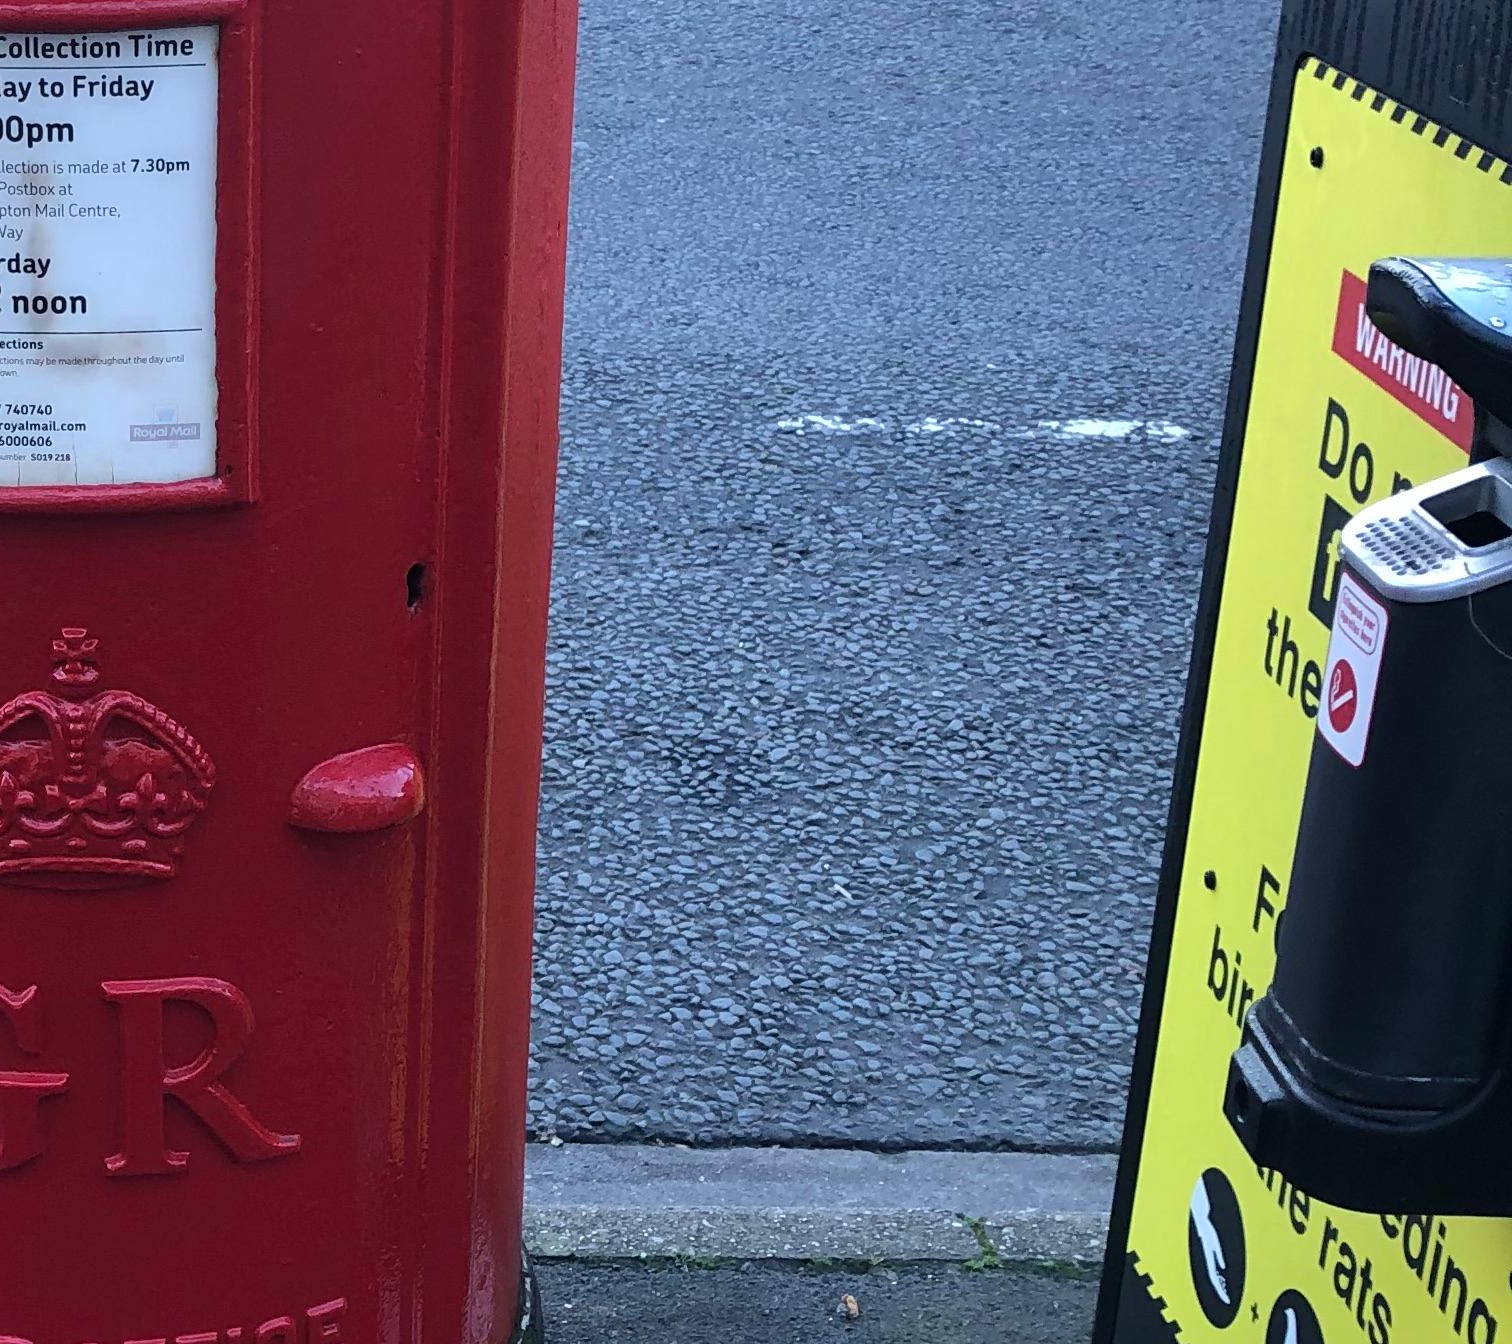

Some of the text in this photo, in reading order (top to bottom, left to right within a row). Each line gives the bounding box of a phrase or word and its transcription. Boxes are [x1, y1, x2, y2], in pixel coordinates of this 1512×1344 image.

[128, 34, 193, 57] Time
[38, 78, 64, 97] to
[73, 75, 154, 101] Friday
[54, 161, 63, 174] is
[68, 160, 108, 174] made
[113, 161, 126, 173] at
[131, 159, 189, 174] 7.30pm
[59, 184, 73, 195] at
[36, 204, 64, 217] Mail
[69, 204, 120, 218] Centre,
[12, 296, 86, 314] noon
[5, 404, 52, 415] 740740
[134, 426, 197, 438] Royal Mail
[1318, 396, 1374, 505] Do
